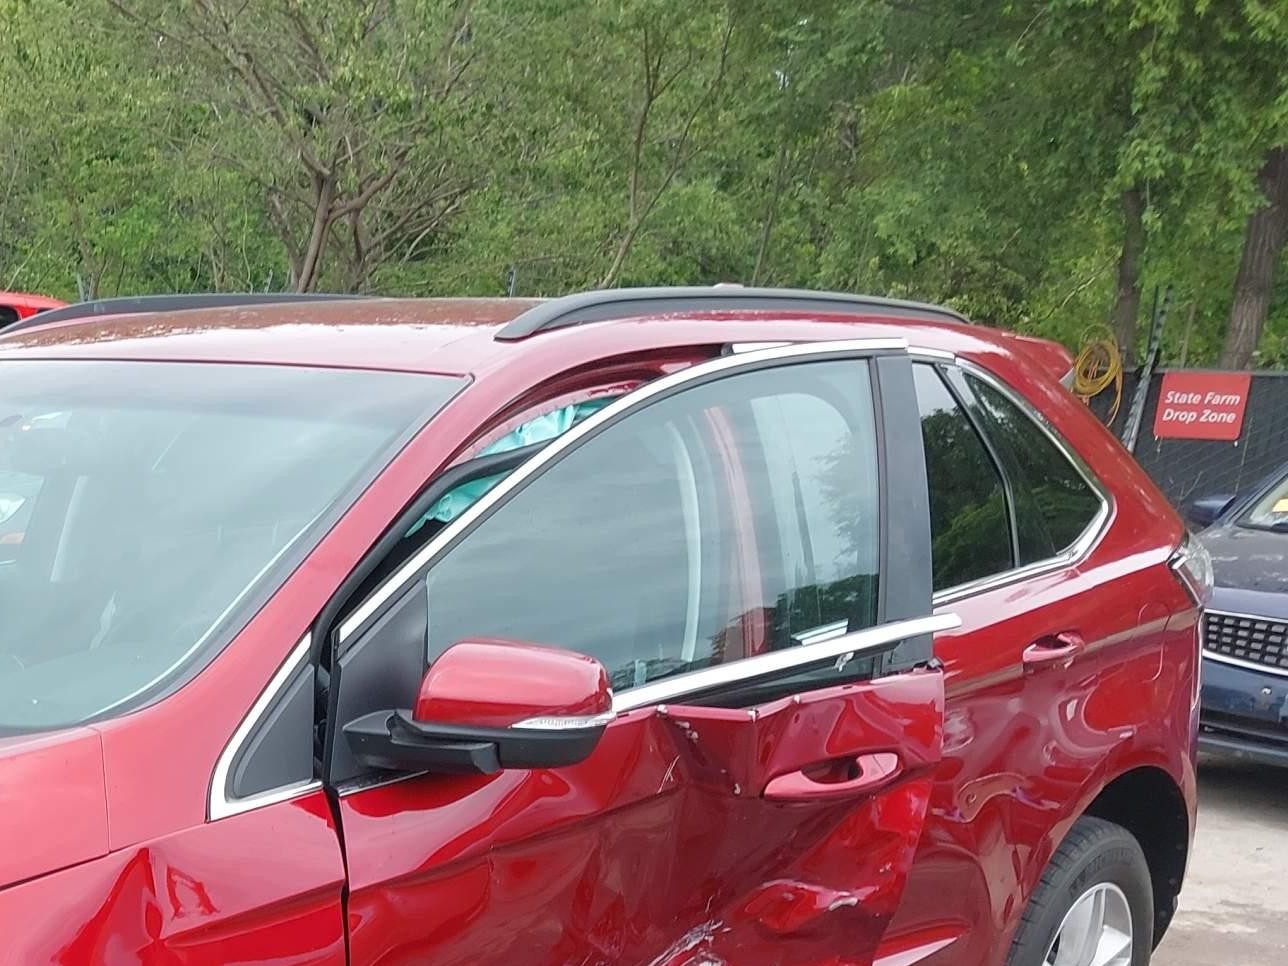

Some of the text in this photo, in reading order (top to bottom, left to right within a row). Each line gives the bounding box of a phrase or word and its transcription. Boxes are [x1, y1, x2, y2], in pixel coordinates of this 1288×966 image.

[1165, 391, 1241, 406] State Farm
[1162, 408, 1237, 425] Drop Zone
